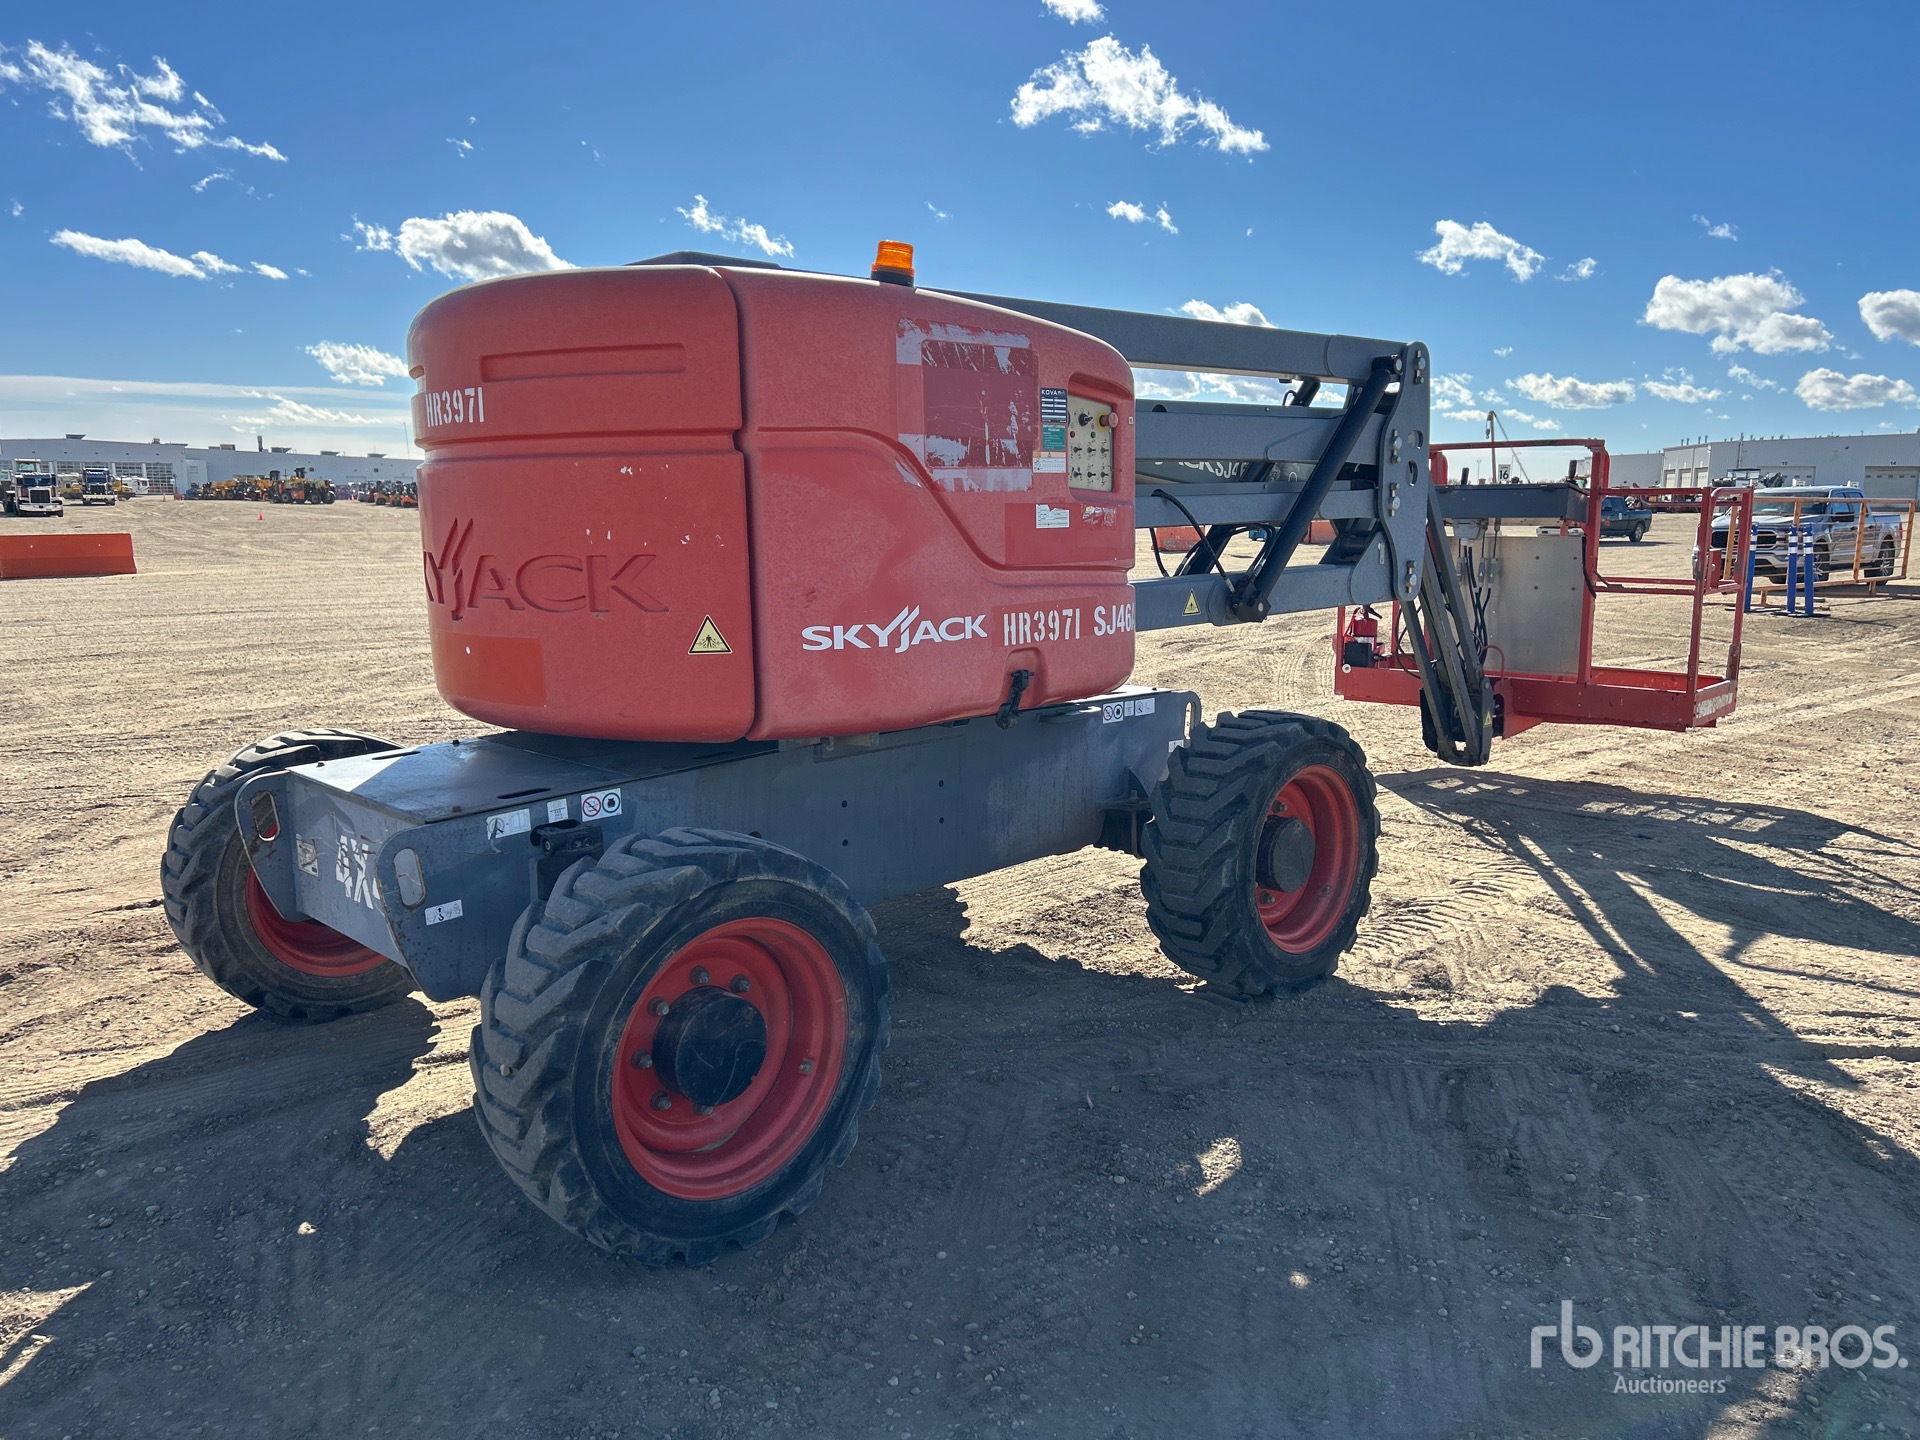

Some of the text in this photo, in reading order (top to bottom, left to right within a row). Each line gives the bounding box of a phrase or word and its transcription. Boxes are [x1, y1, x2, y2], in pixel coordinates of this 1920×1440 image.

[425, 387, 484, 427] HR3971
[1499, 470, 1509, 480] 16
[801, 605, 988, 653] SKYJACK
[1003, 608, 1080, 646] HR3971
[336, 835, 381, 909] 4X
